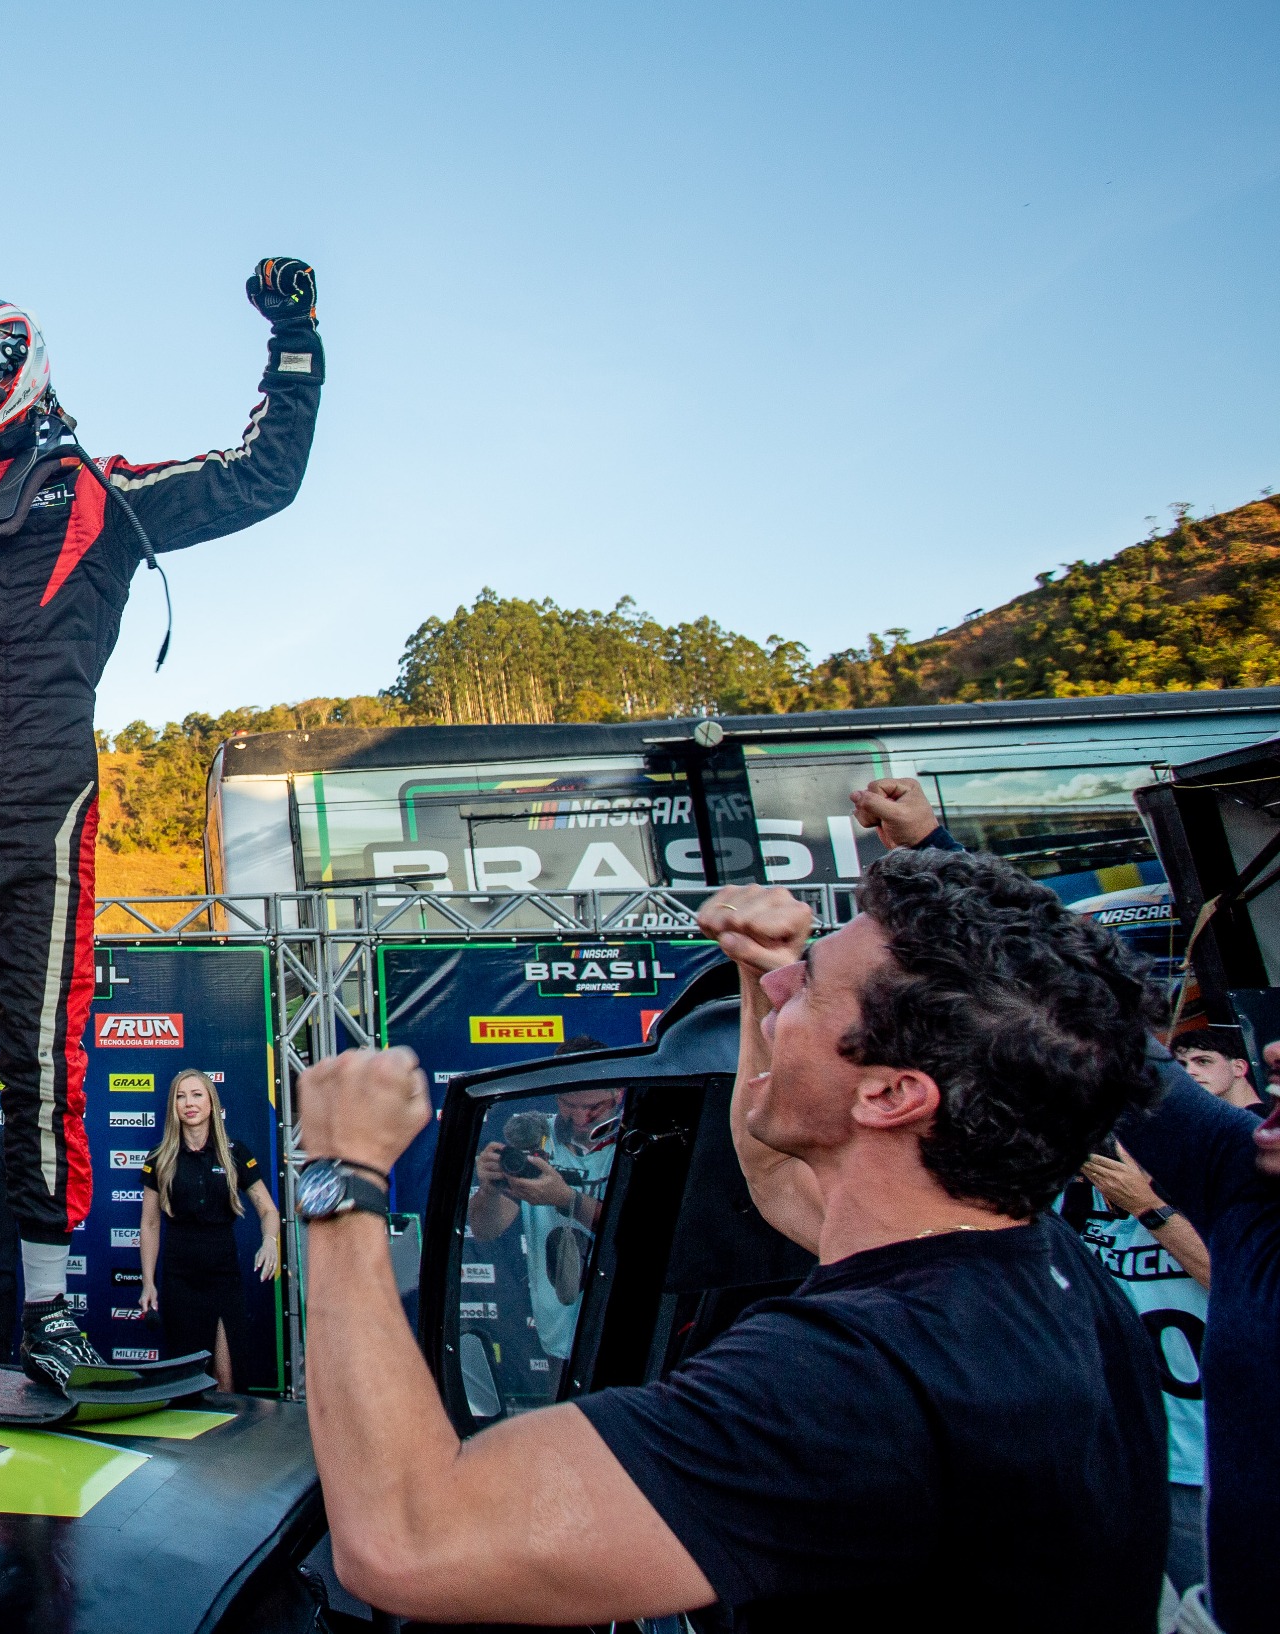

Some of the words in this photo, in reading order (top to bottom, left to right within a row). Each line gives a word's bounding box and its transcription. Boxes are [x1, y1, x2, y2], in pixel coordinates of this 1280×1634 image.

[568, 796, 692, 829] NASCAR
[1099, 904, 1172, 924] NASCAR
[583, 949, 620, 959] NASCAR
[525, 961, 676, 982] BRASIL
[576, 983, 600, 991] SPRINT
[601, 983, 620, 991] RACE
[99, 1016, 179, 1037] FRUM
[479, 1021, 554, 1038] PIRELLI
[113, 1078, 151, 1087] GRAXA
[110, 1112, 154, 1127] zanoello
[113, 1230, 141, 1238] TECPA
